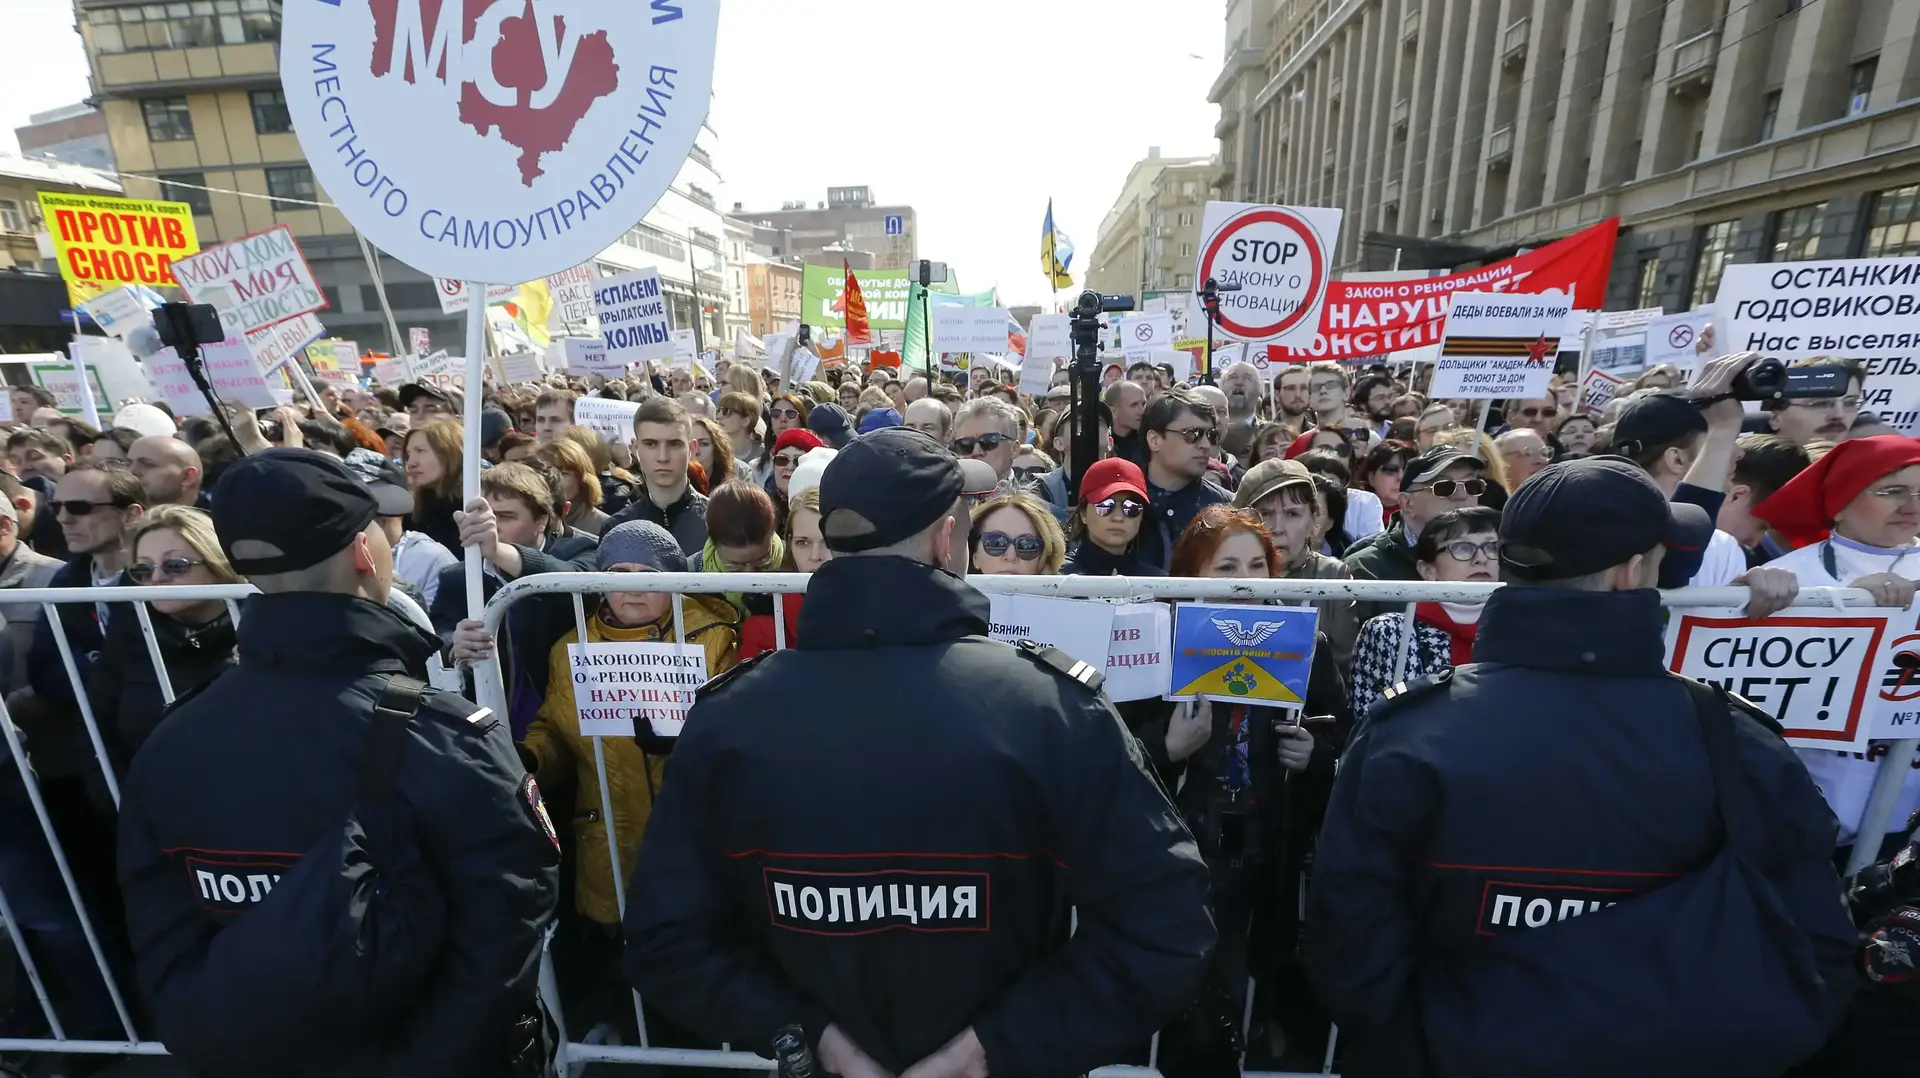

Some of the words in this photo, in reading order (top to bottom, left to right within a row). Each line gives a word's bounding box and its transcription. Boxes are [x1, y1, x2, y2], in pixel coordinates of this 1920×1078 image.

[311, 43, 407, 217] МЕСТНОГО
[420, 64, 678, 250] САМОУПРАВЛЕНИЯ
[55, 209, 188, 249] ПРОТИВ
[178, 245, 241, 289] МОЙ
[242, 228, 295, 270] ДОМ
[1232, 238, 1298, 265] STOP
[229, 258, 301, 302] МОЯ
[1220, 269, 1285, 287] ЗАКОНУ
[1288, 275, 1301, 289] О
[1345, 286, 1394, 299] ЗАКОН
[1398, 285, 1410, 297] О
[1414, 264, 1513, 295] РЕНОВАЦИИ
[559, 285, 582, 303] ВАС
[594, 277, 659, 307] #СПАСЕМ
[219, 282, 320, 329] РЕПОСТЬ
[599, 302, 664, 325] КРЫЛАТСКИЕ
[1217, 293, 1302, 314] ЕНОВАЦИИ
[1453, 305, 1483, 318] ДЕДЫ
[1485, 306, 1532, 318] ВОЕВАЛИ
[1533, 307, 1544, 318] ЗА
[1546, 307, 1568, 318] МИР
[604, 321, 669, 350] ХОЛМЫ
[1746, 332, 1800, 350] Нас
[585, 354, 606, 362] НЕТ
[1439, 360, 1487, 371] ДОЛЬЩИКИ
[1463, 374, 1496, 383] ВОЮЮТ
[1497, 374, 1508, 383] ЗА
[1508, 374, 1526, 384] ДОМ
[1592, 379, 1616, 395] СНО
[1474, 386, 1516, 394] ВЕРНАДСКОГО
[593, 413, 635, 422] аварийны
[987, 622, 1030, 637] ОБЯНИН!
[572, 654, 703, 668] ЗАКОНОПРОЕКТ
[1106, 652, 1161, 669] ации
[1703, 637, 1855, 668] СНОСУ
[574, 672, 587, 684] О
[591, 671, 705, 685] «РЕНОВАЦИИ»
[590, 689, 696, 703] НАРУШАЕТ
[196, 869, 281, 903] ПОЛ
[774, 881, 977, 925] ПОЛИЦИЯ
